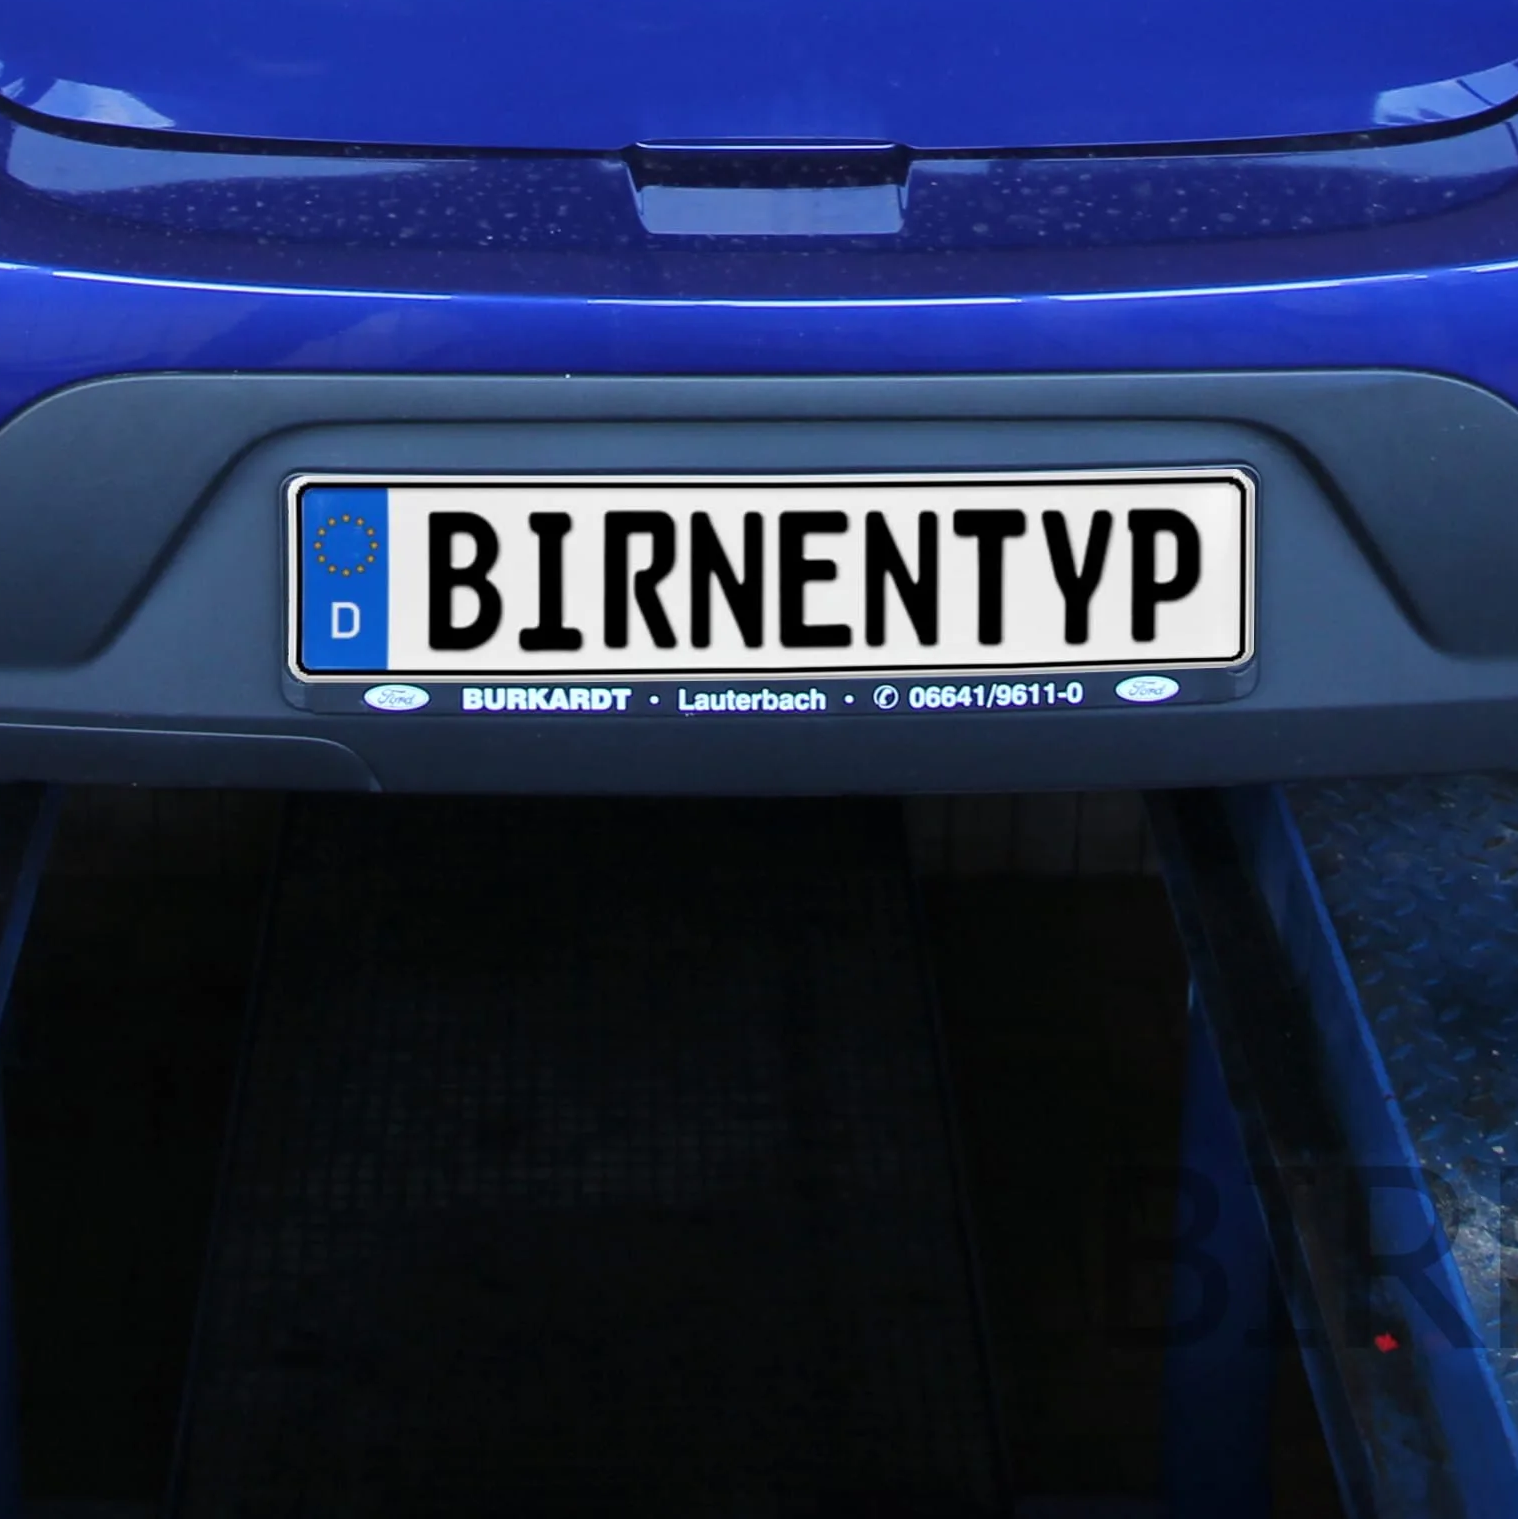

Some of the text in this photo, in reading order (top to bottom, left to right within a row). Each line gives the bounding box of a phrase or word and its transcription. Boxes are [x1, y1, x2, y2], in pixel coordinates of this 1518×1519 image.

[427, 508, 1203, 653] BIRNENTYP
[331, 601, 362, 640] D
[377, 688, 416, 707] Ford
[462, 681, 1084, 713] BURKARDT Lauterbach 06641/9611-0
[1128, 680, 1167, 699] Ford
